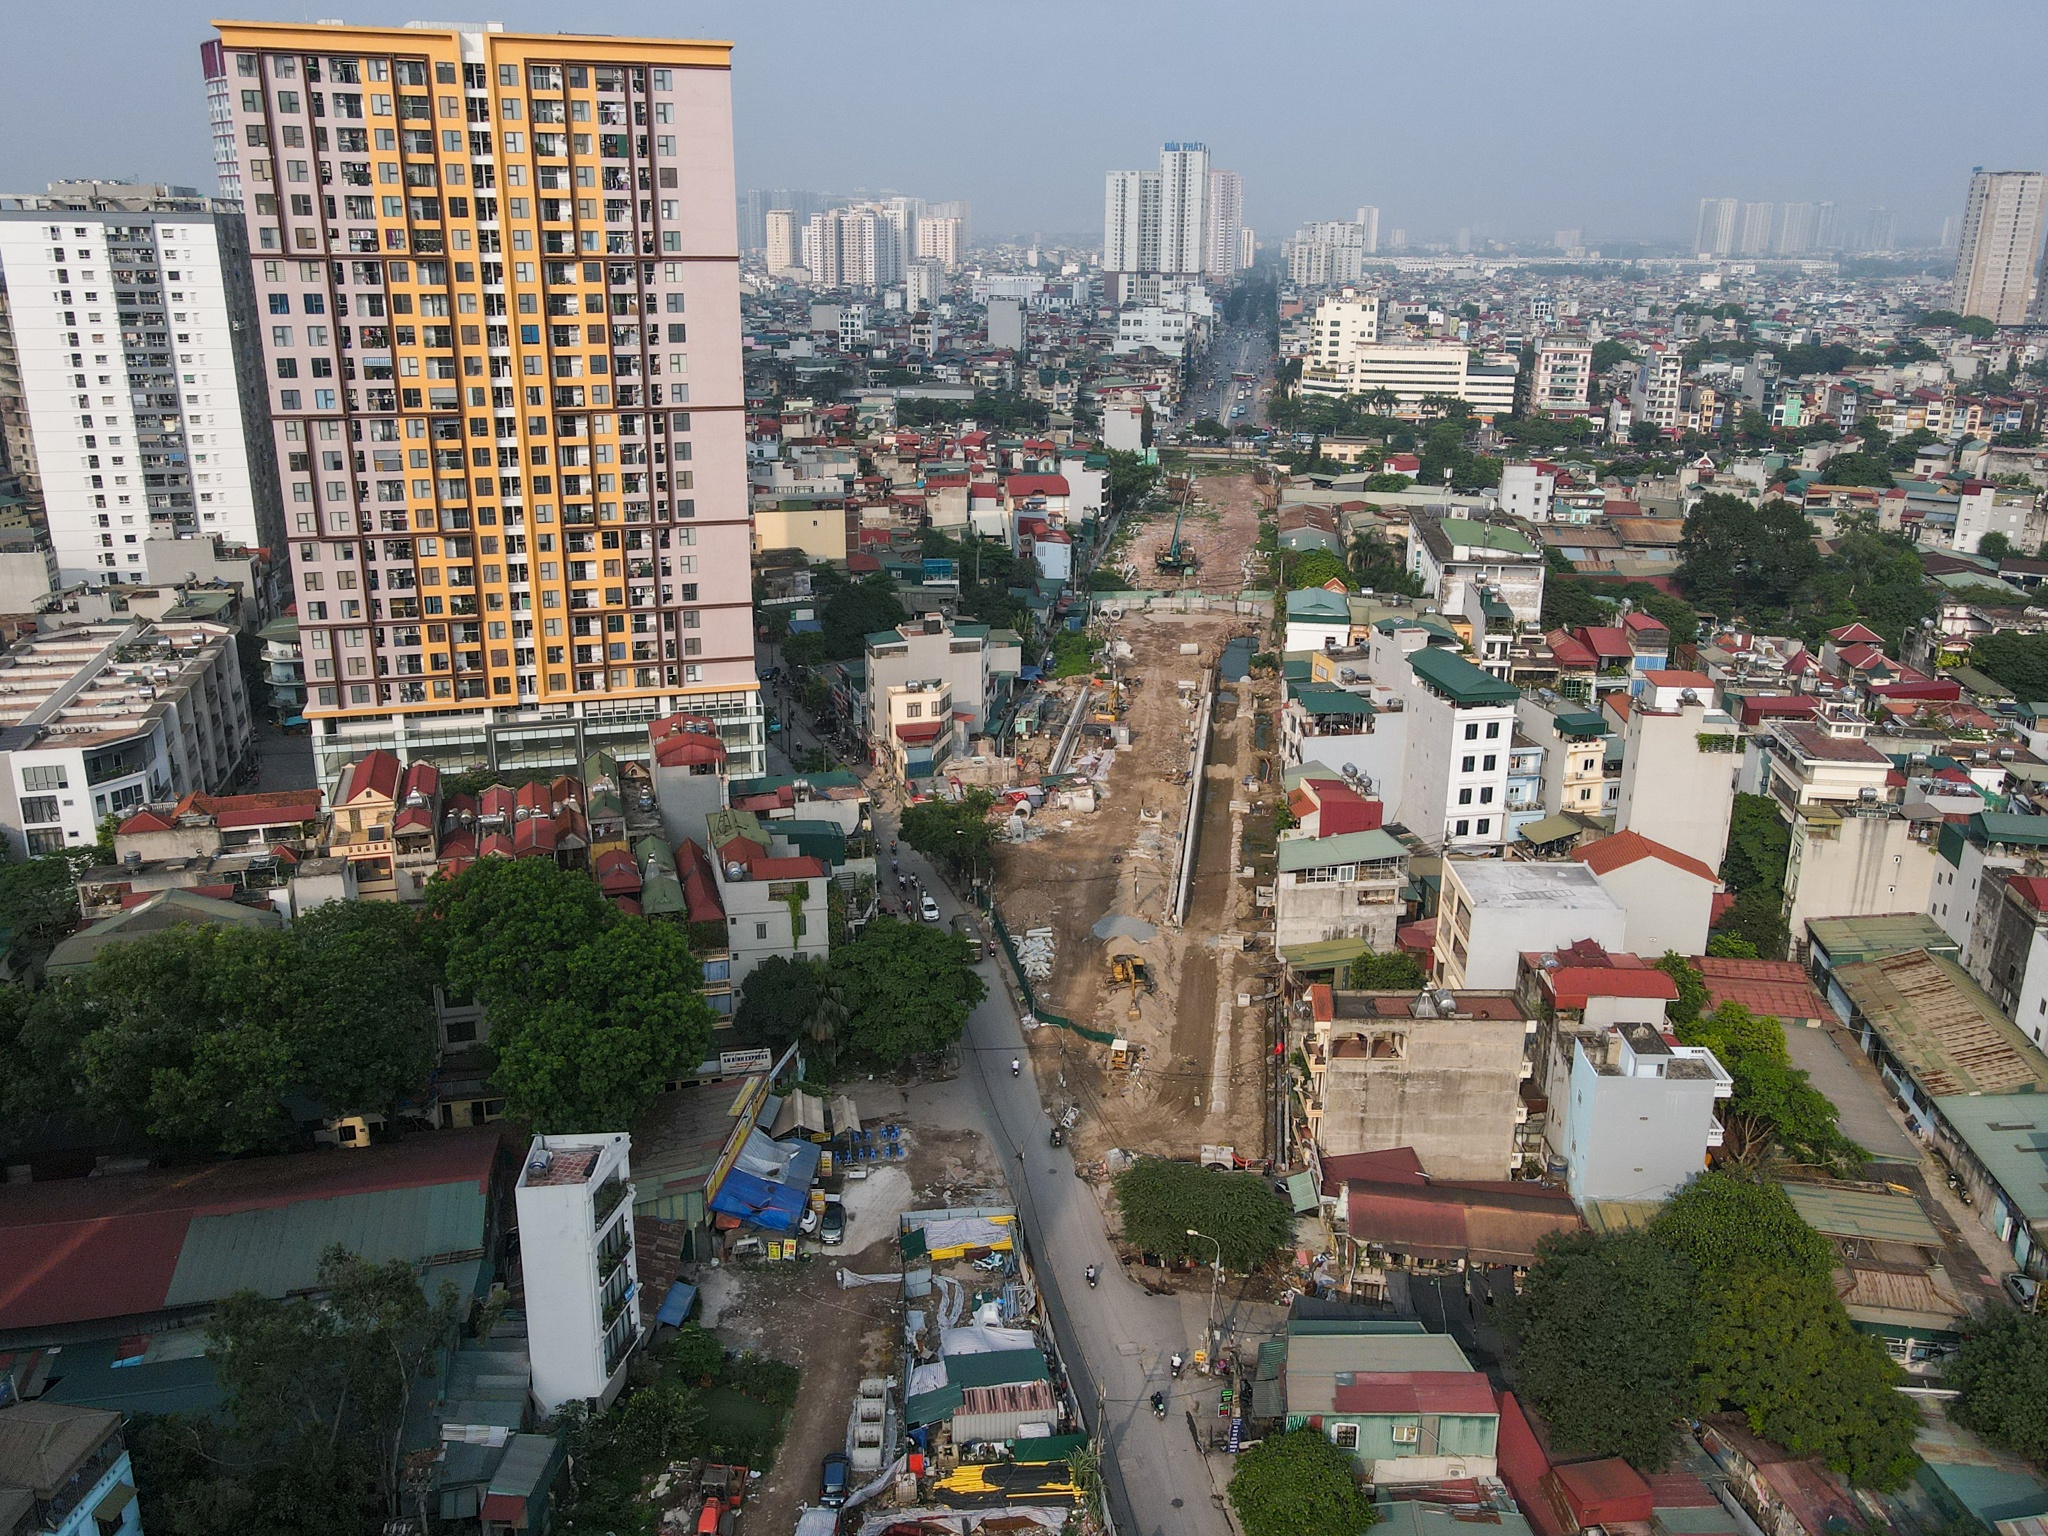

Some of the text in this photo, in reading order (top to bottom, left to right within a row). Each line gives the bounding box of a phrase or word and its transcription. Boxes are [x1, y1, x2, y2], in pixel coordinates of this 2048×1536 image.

[1182, 141, 1203, 151] PHÁT
[1328, 295, 1374, 305] mobifone
[745, 1054, 768, 1062] EXPRESS
